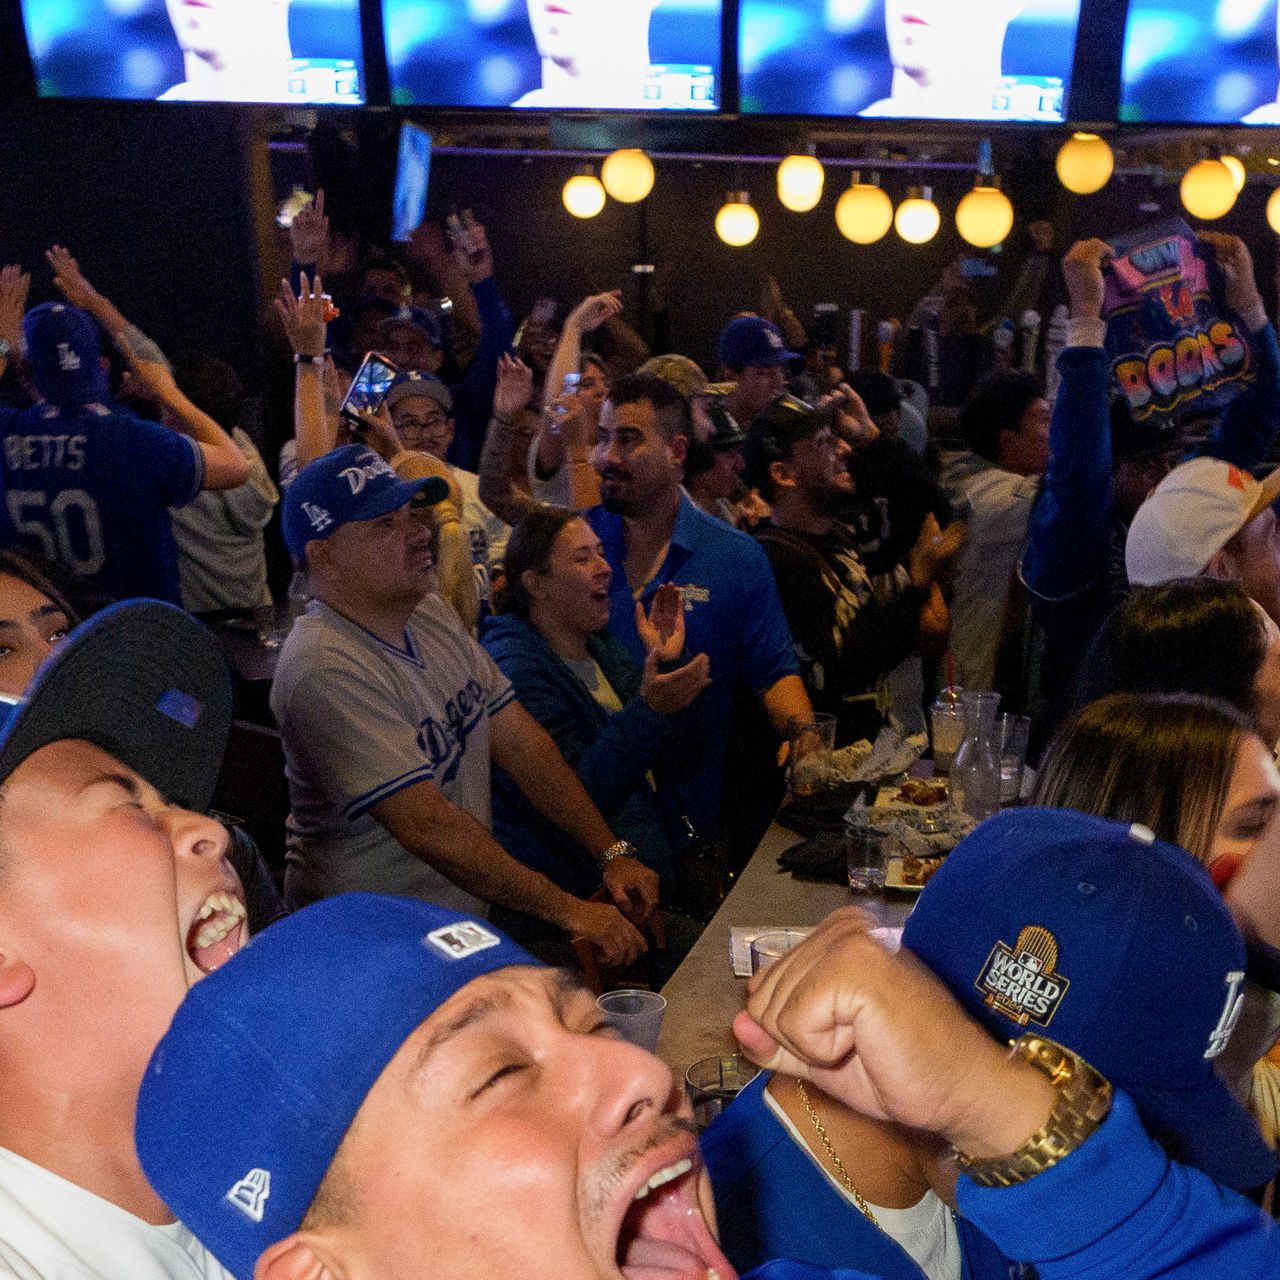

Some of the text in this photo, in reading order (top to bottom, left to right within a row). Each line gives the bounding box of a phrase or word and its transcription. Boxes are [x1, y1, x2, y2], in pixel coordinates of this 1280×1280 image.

[3, 434, 88, 471] BETTS
[6, 489, 106, 576] 50
[985, 969, 1050, 1014] SERIES
[993, 951, 1060, 1000] WORLD
[996, 992, 1023, 1014] 2024
